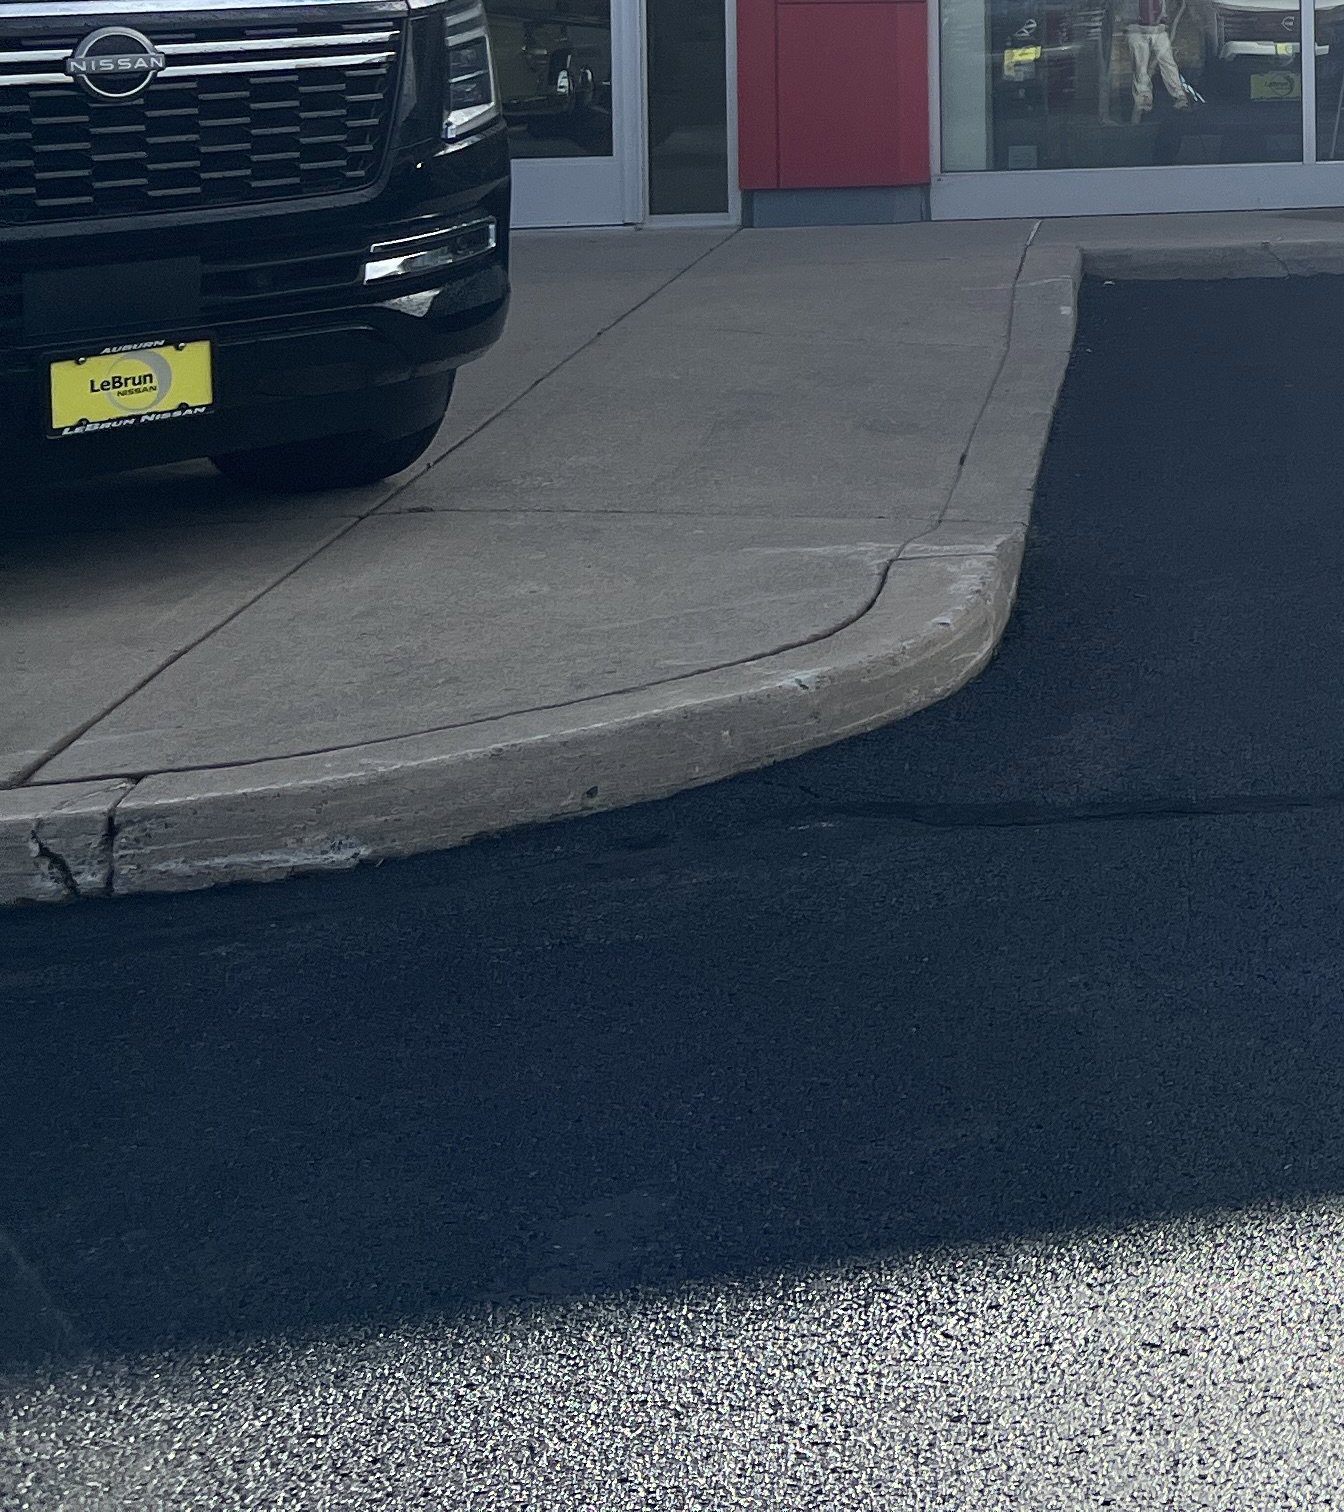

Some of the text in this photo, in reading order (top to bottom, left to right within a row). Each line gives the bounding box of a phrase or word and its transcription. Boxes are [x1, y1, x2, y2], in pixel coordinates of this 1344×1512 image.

[69, 57, 163, 71] NISSAN
[100, 340, 165, 355] AUBURN
[90, 373, 153, 393] LeBrun
[117, 386, 157, 397] NISSAN
[140, 406, 206, 423] NISSAN
